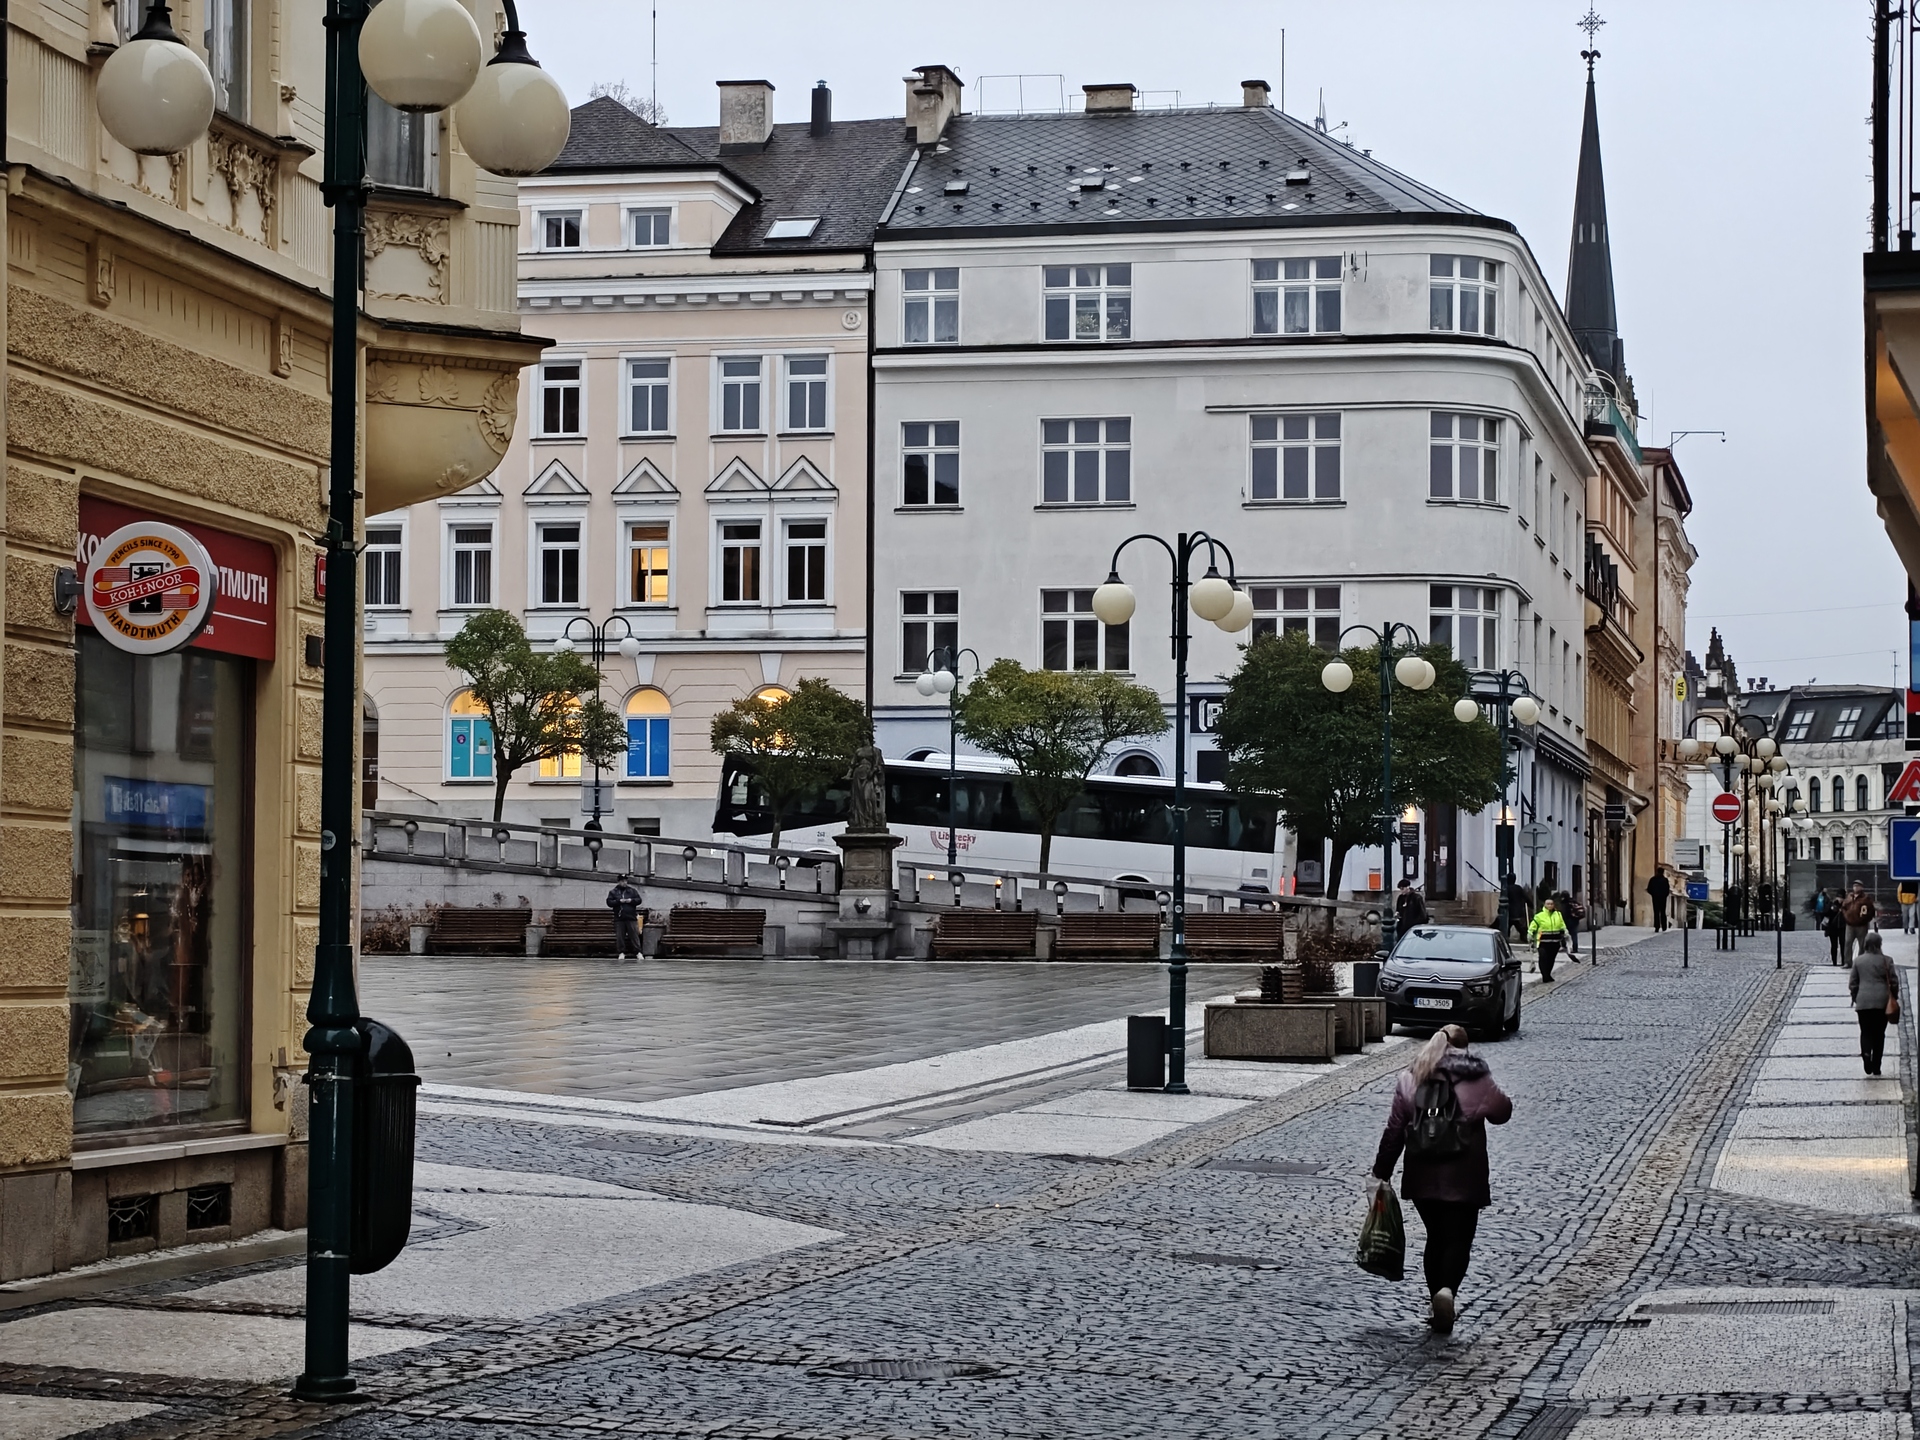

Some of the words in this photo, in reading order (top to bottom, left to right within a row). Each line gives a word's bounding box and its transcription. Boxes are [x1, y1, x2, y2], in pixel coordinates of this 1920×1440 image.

[111, 540, 139, 564] PENCILS
[140, 539, 163, 550] SINCE
[163, 544, 181, 560] 1790
[110, 573, 183, 604] KOH-I-NOOR
[216, 565, 268, 605] TMUTH
[108, 610, 181, 639] HARDTMUTH
[938, 831, 976, 844] Librecký
